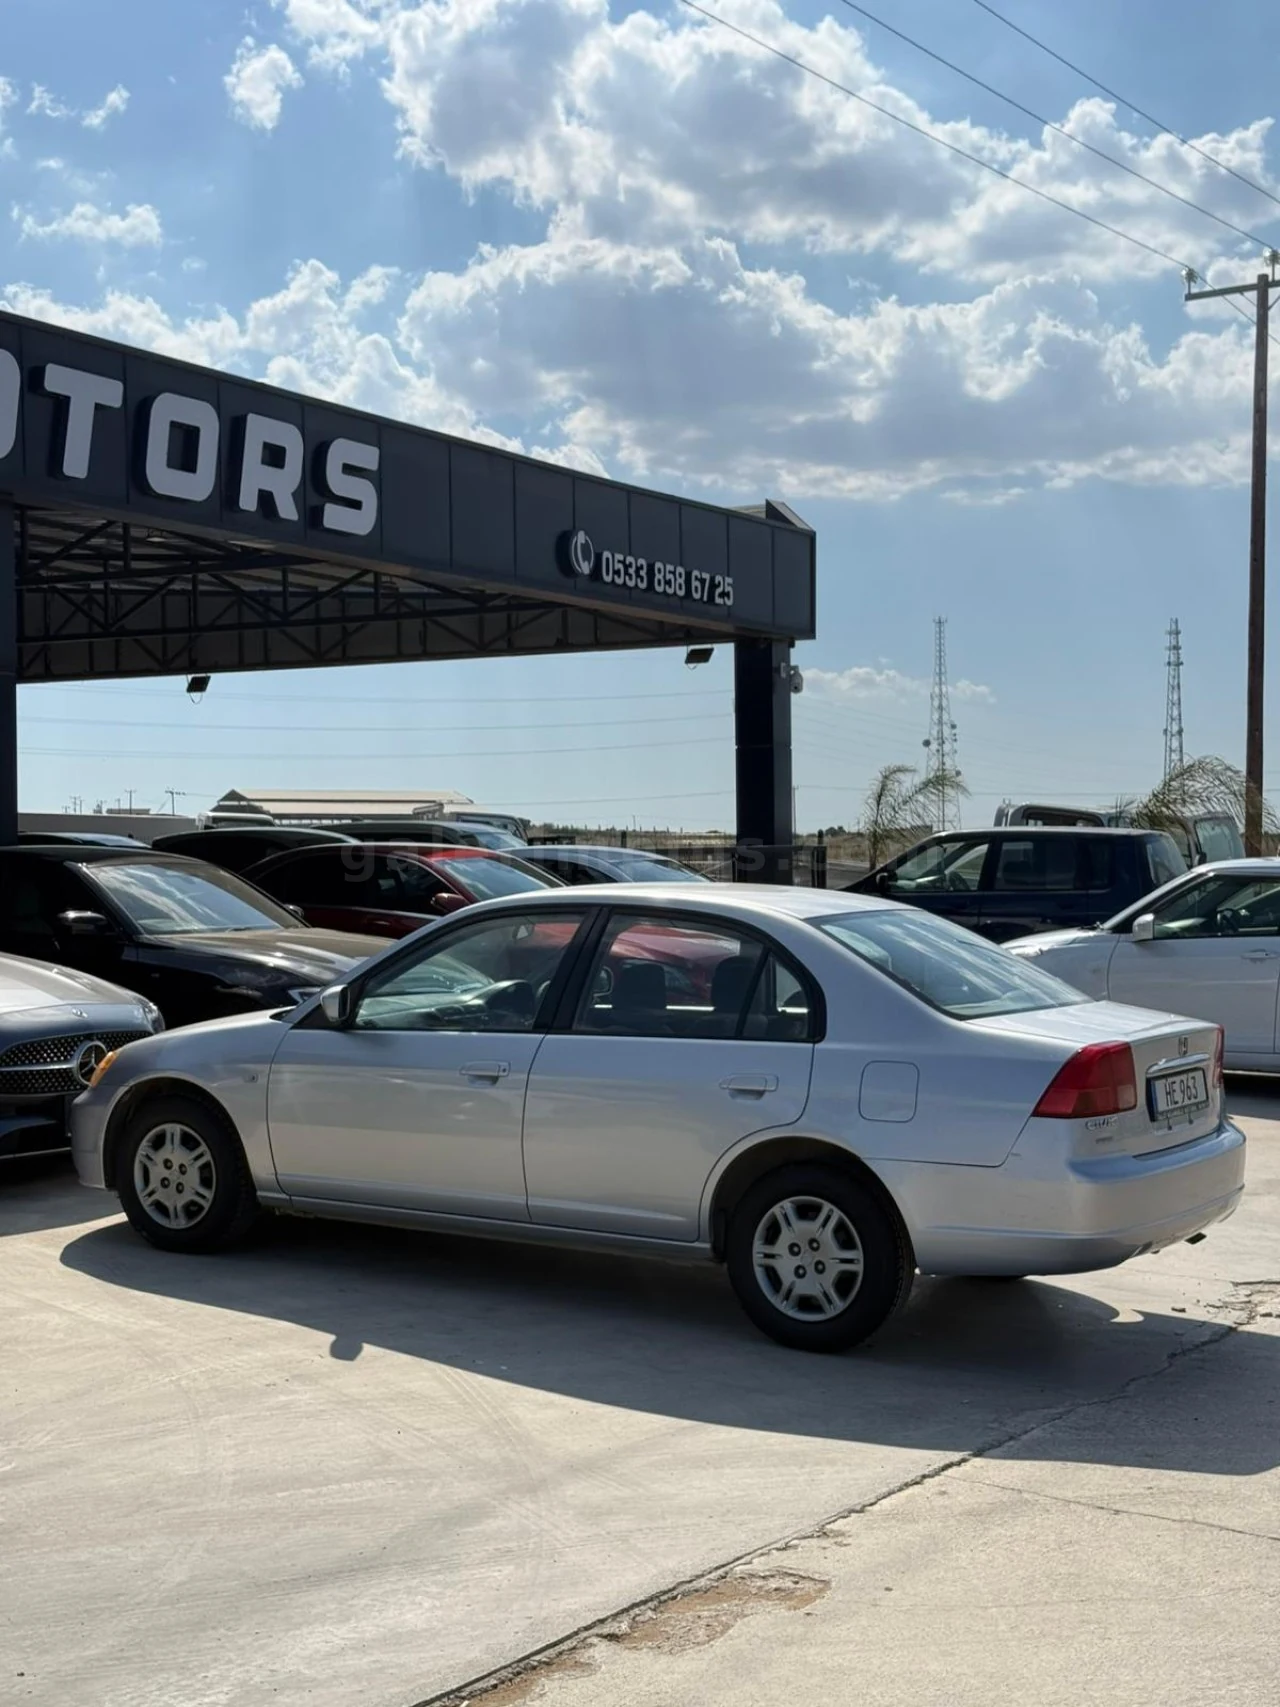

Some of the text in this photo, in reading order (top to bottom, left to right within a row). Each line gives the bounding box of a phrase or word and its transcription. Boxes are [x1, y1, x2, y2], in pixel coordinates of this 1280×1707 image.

[0, 348, 381, 536] TORS
[602, 551, 734, 606] 0533 858 67 25
[1165, 1076, 1198, 1107] HE 963
